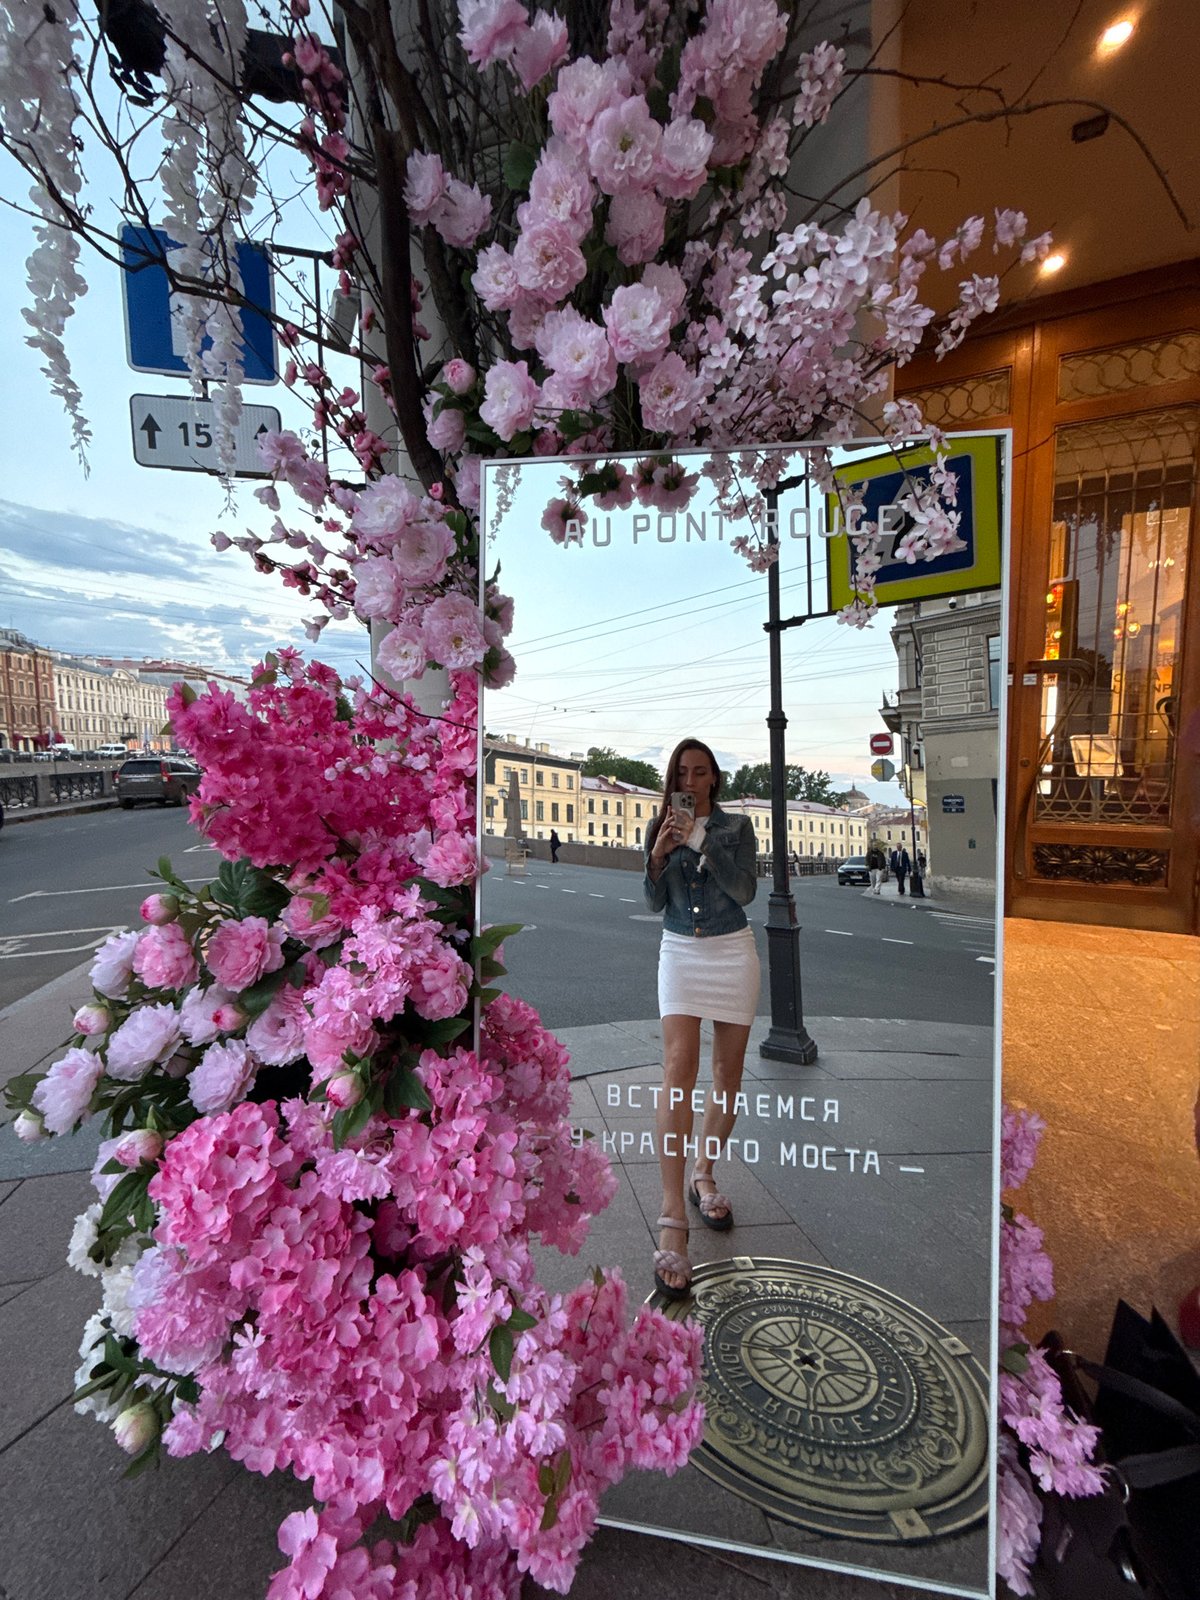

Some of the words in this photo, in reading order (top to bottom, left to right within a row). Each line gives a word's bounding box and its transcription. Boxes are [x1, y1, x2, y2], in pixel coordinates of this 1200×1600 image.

[178, 422, 213, 448] 15
[563, 514, 612, 549] AU
[633, 510, 728, 545] PONT
[760, 503, 899, 540] ROUGE
[606, 1083, 841, 1124] ВСТРЕЧАЕМСЯ
[570, 1127, 585, 1149] У
[602, 1130, 761, 1164] КРАСНОГО
[780, 1141, 881, 1175] МОСТА
